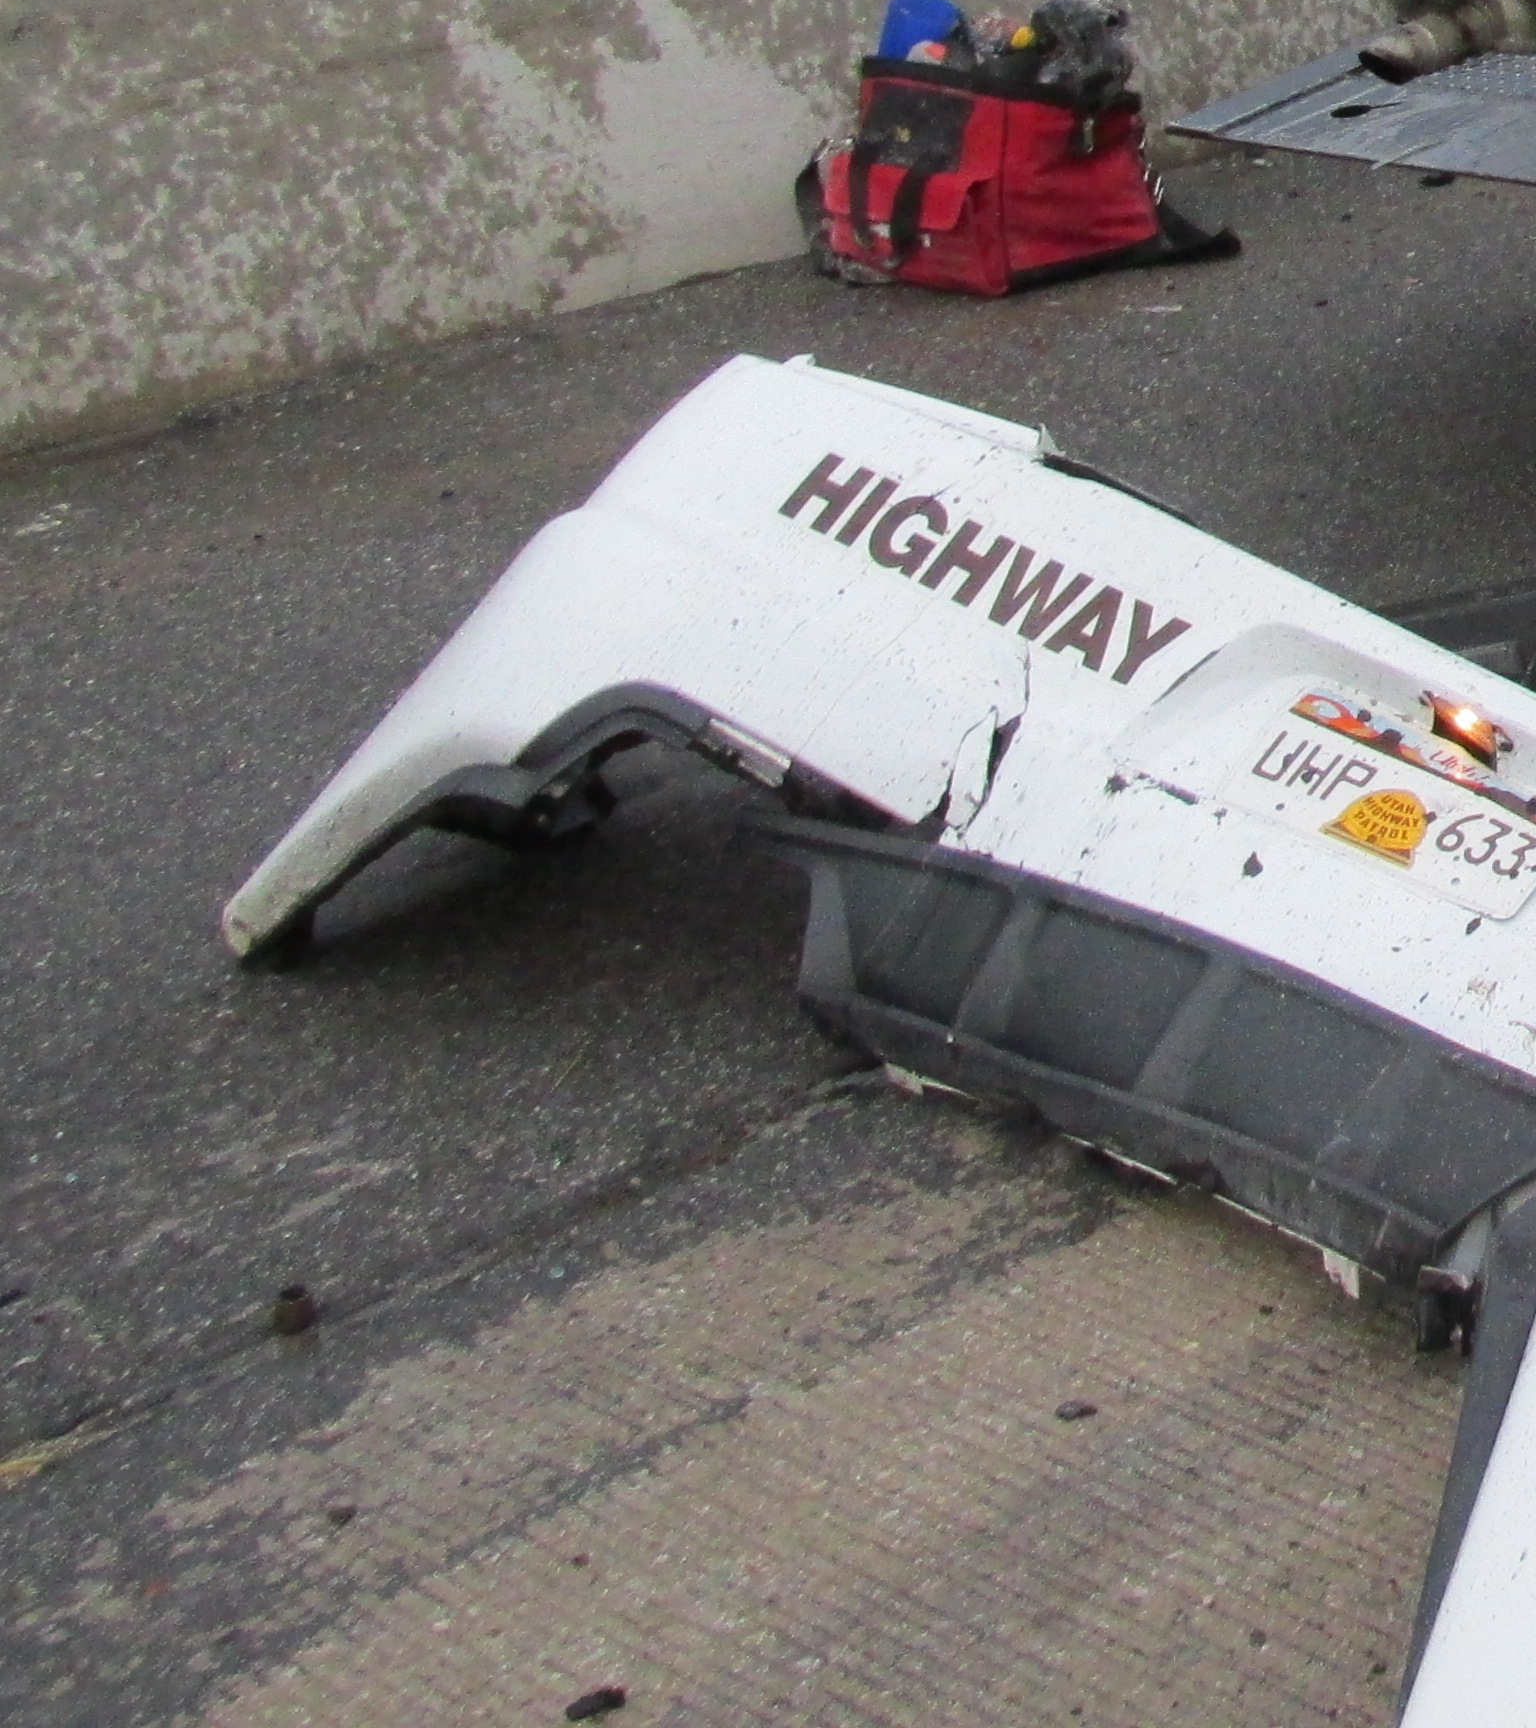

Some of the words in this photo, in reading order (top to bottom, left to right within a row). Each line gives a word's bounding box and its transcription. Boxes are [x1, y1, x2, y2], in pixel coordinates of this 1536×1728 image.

[778, 453, 1193, 685] HIGHWAY
[1252, 731, 1378, 800] UHP
[1362, 796, 1419, 828] HIGHWAY
[1381, 794, 1416, 814] UTAH
[1354, 809, 1409, 840] PATROL
